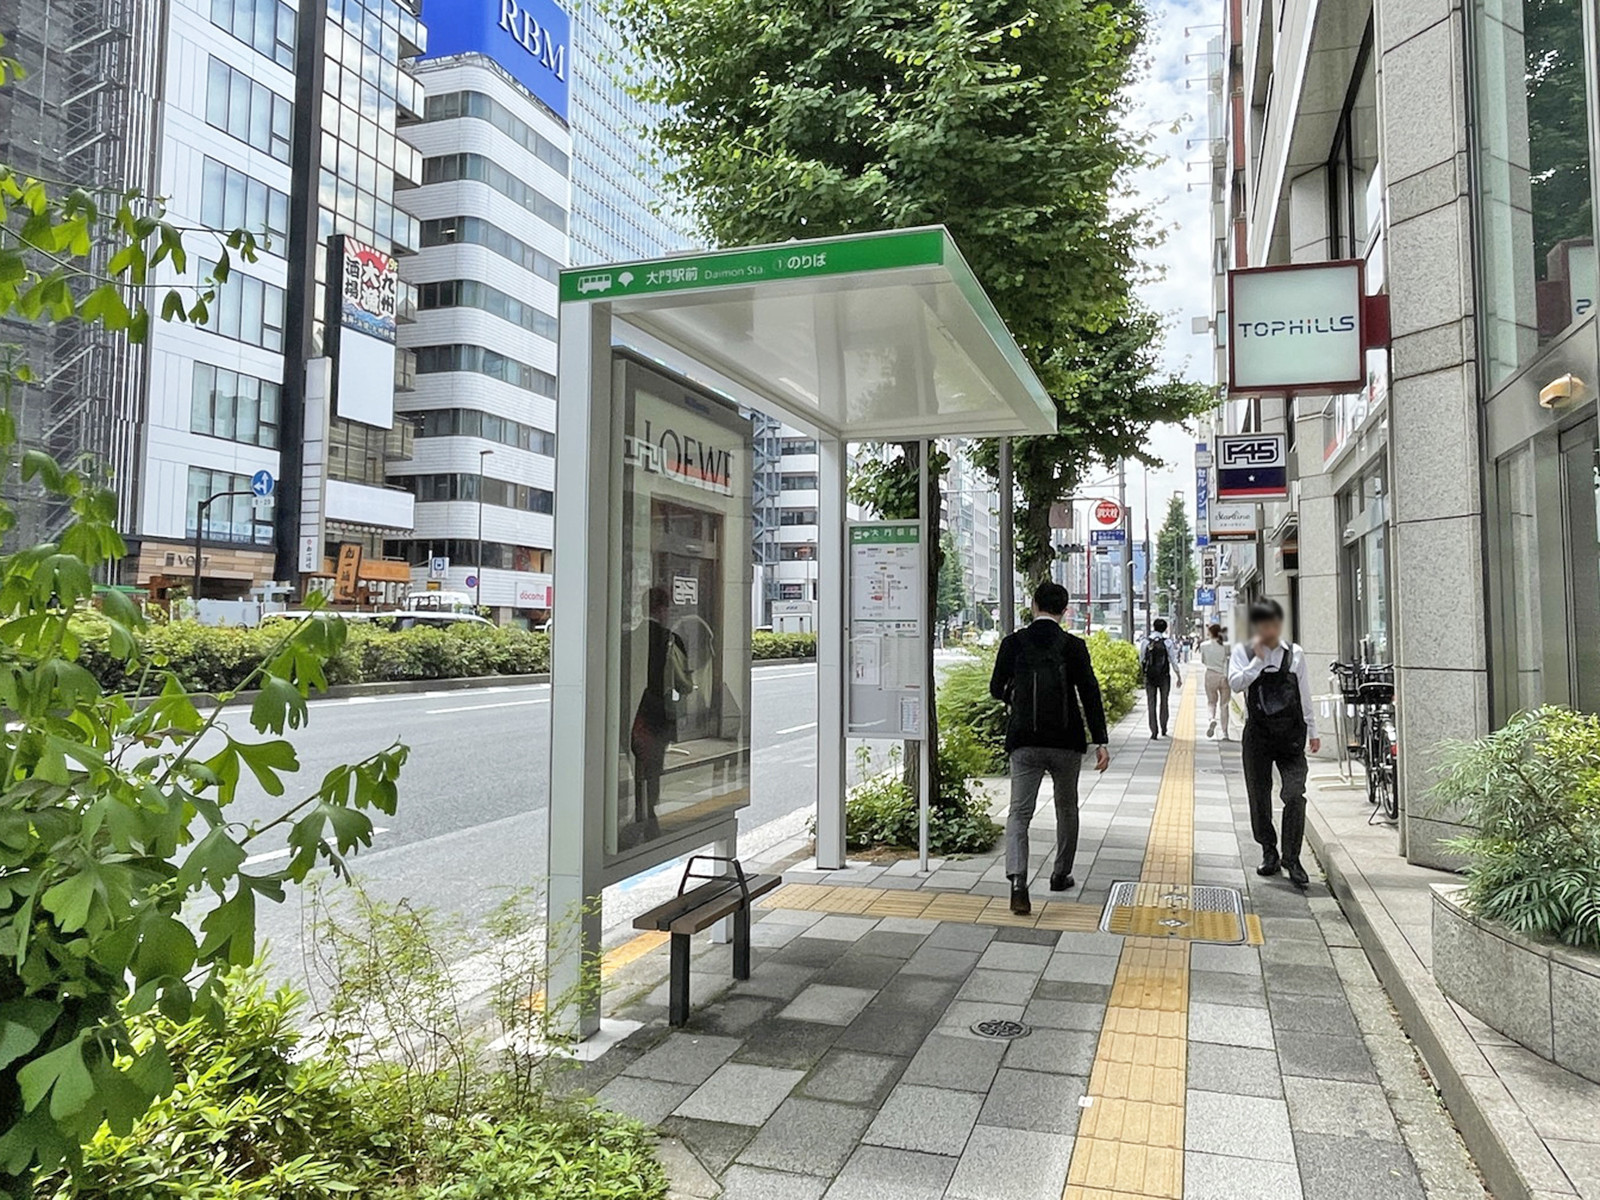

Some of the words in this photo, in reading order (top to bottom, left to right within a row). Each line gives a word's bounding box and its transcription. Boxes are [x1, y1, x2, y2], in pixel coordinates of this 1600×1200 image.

[497, 0, 565, 83] RBM
[345, 255, 359, 299] 酒場
[361, 259, 380, 316] 大漁
[381, 272, 395, 315] 九州
[646, 267, 698, 285] 大門駅前
[704, 268, 744, 280] Daimon
[1223, 438, 1279, 465] F45
[178, 555, 210, 568] VOT
[520, 590, 544, 601] docomo
